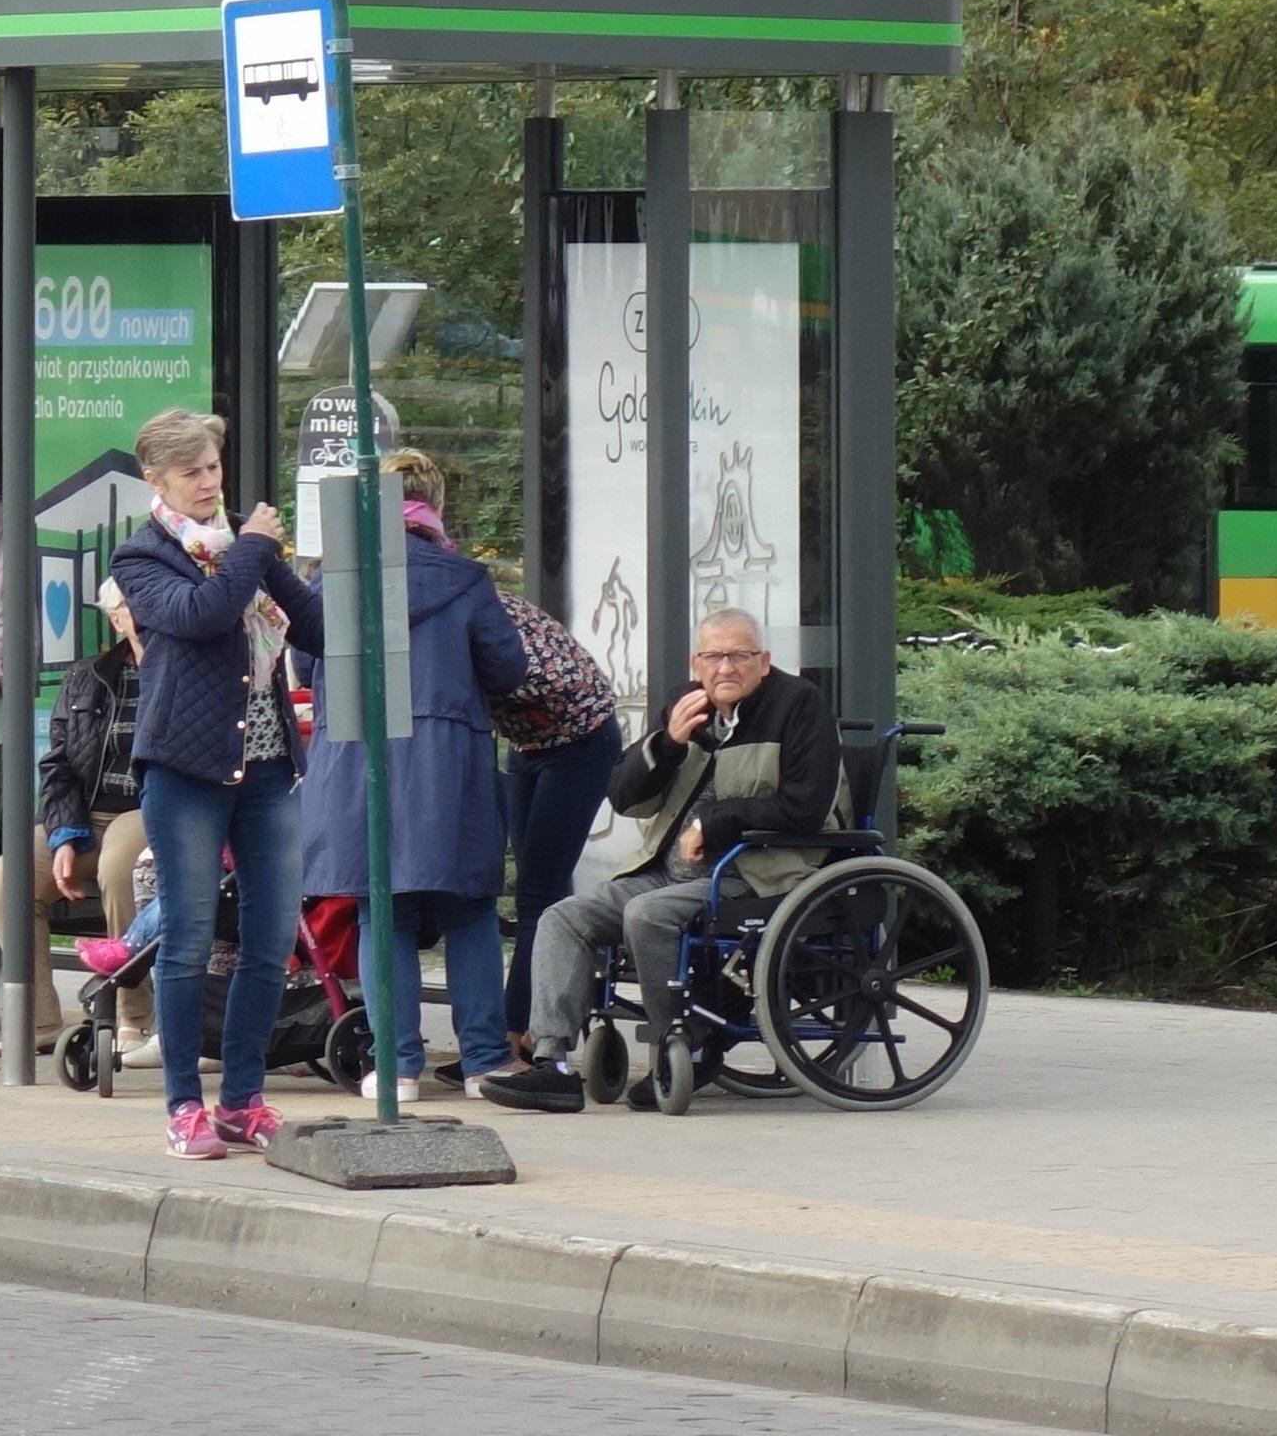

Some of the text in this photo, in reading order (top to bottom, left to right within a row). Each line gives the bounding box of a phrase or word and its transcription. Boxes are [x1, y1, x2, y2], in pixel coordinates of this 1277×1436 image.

[35, 275, 189, 346] 600 nowych
[68, 354, 191, 384] przystankowych
[58, 394, 124, 418] Poznania
[312, 397, 358, 413] rowe
